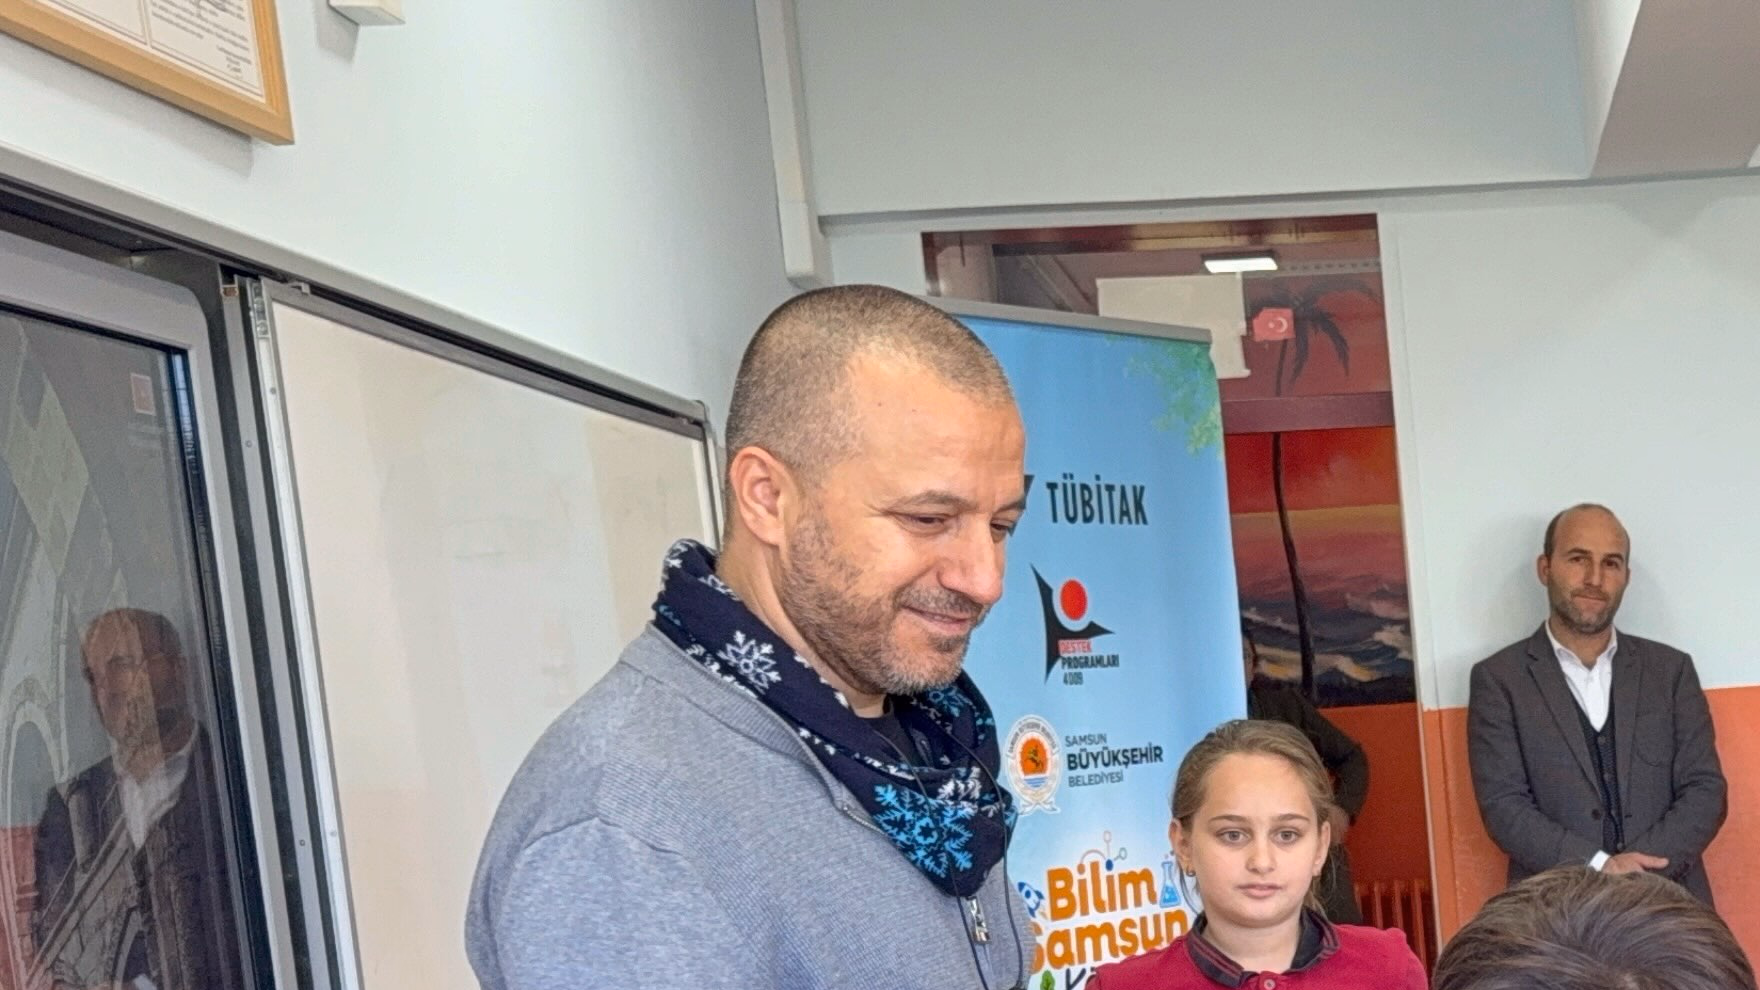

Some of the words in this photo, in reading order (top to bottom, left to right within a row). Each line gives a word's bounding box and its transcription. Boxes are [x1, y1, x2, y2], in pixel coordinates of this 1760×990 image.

[1046, 472, 1149, 526] TÜBİTAK
[1065, 733, 1107, 748] SAMSUN
[1067, 741, 1163, 771] BÜYÜKŞEHİR
[1068, 770, 1124, 788] BELEDİYESİ
[1046, 859, 1157, 922] Bilim
